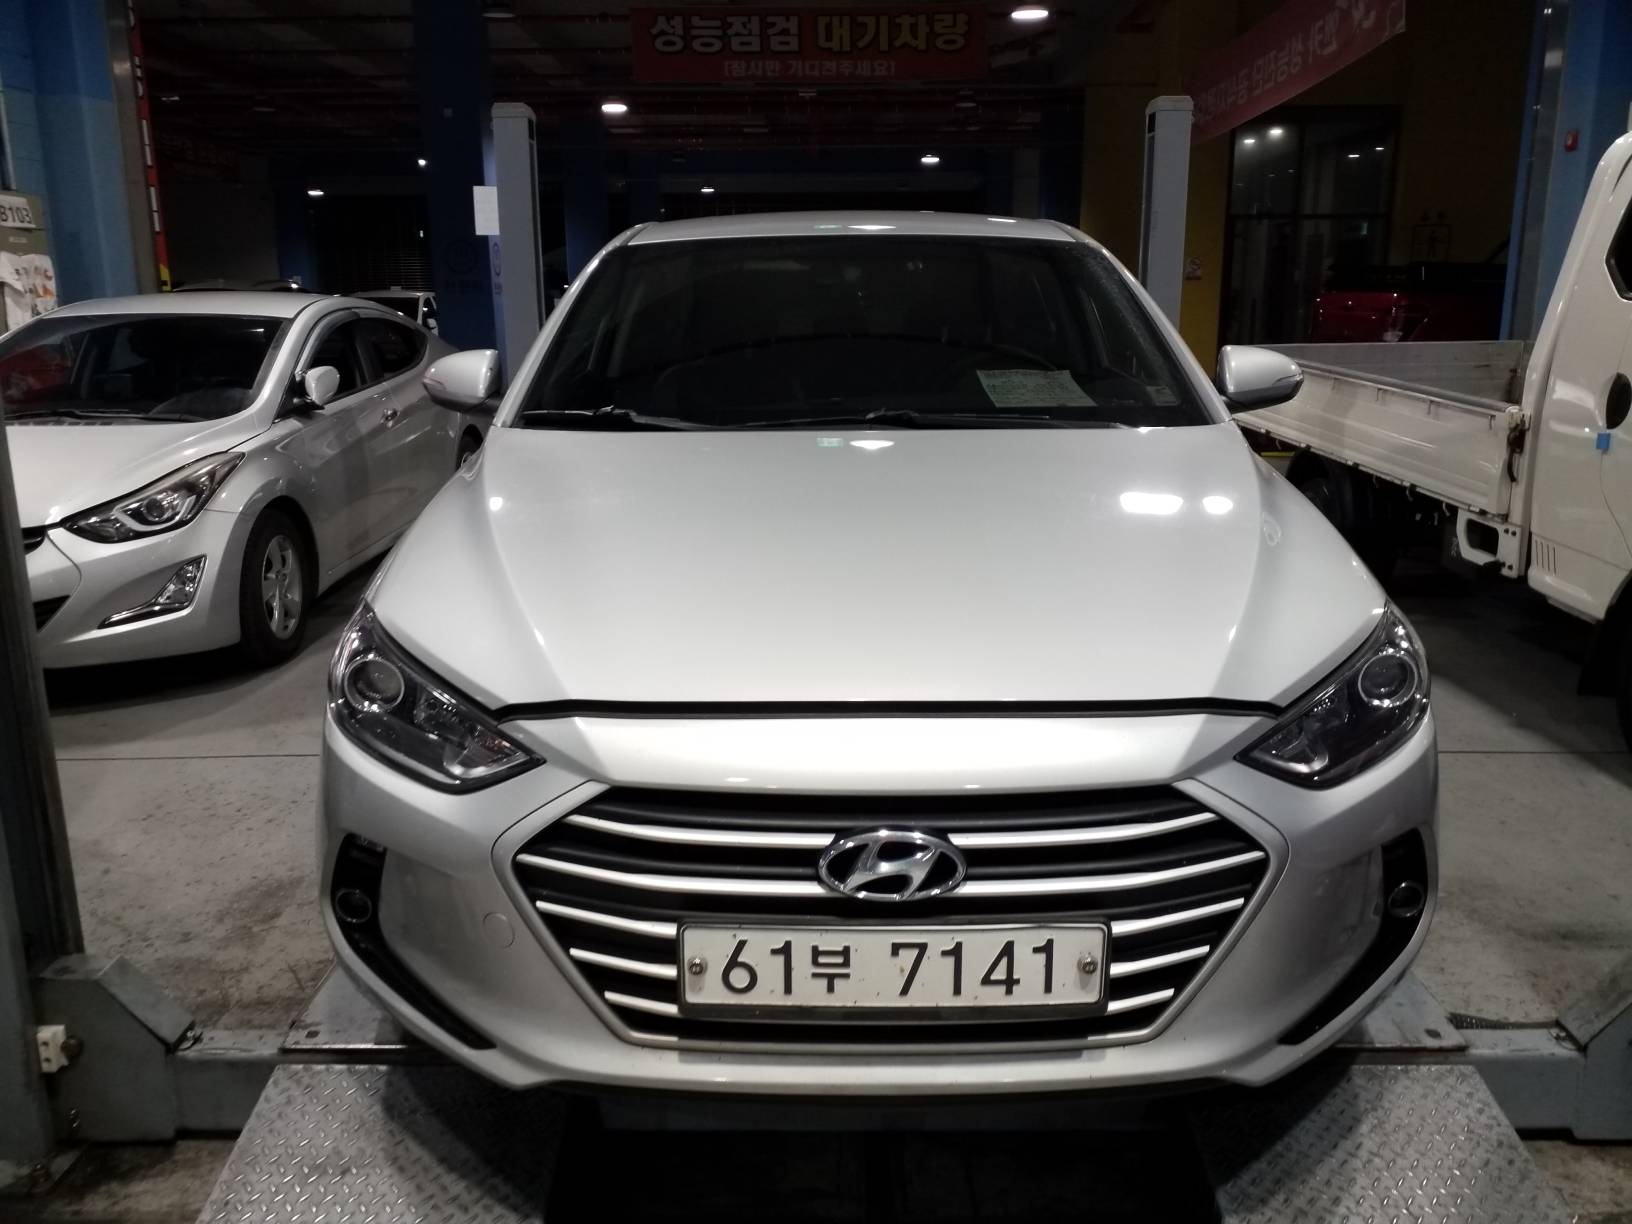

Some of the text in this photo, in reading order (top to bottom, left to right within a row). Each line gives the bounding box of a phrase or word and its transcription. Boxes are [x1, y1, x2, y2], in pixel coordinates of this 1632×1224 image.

[650, 13, 969, 53] 성능점검 대기차량
[721, 938, 1055, 996] 61부 7141
